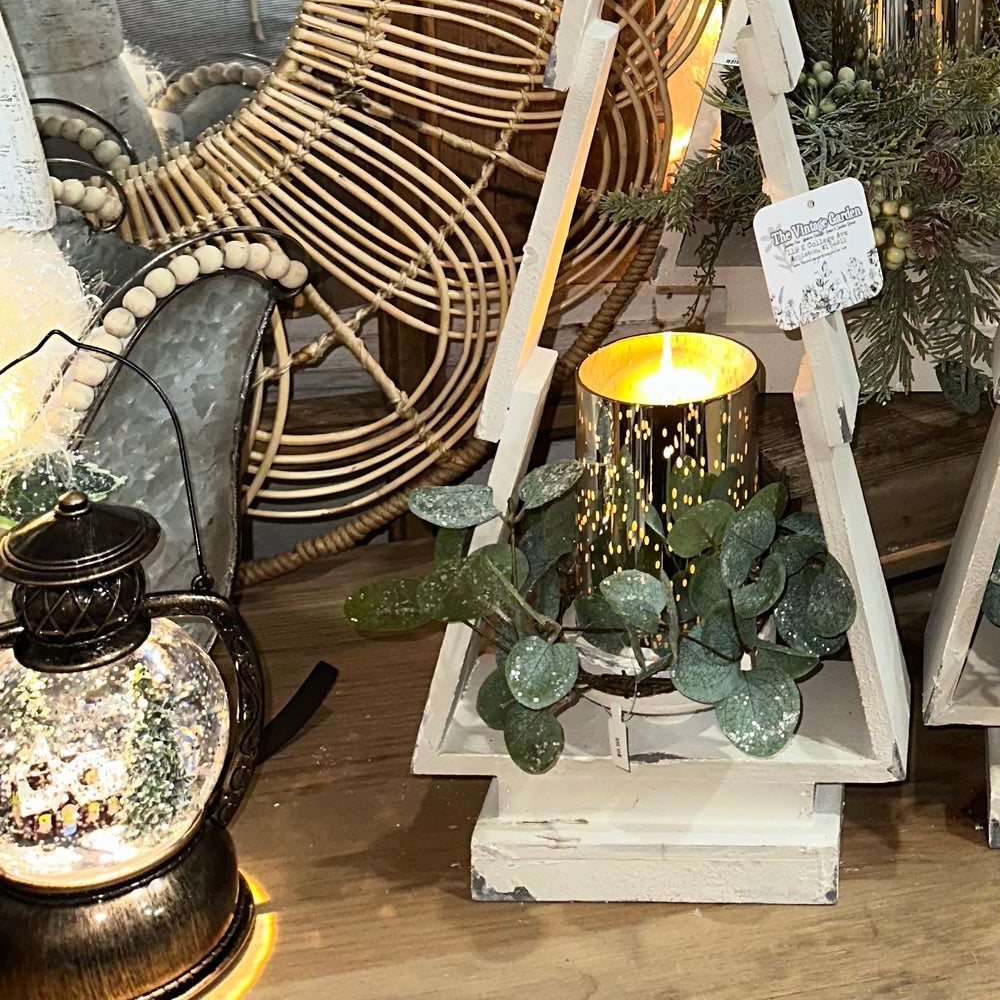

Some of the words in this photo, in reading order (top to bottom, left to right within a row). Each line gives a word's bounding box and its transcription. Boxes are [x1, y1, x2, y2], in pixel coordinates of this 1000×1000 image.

[770, 229, 792, 246] The
[790, 217, 829, 239] Vintage
[828, 205, 863, 226] Garden
[808, 235, 835, 249] College
[837, 230, 848, 239] Ave
